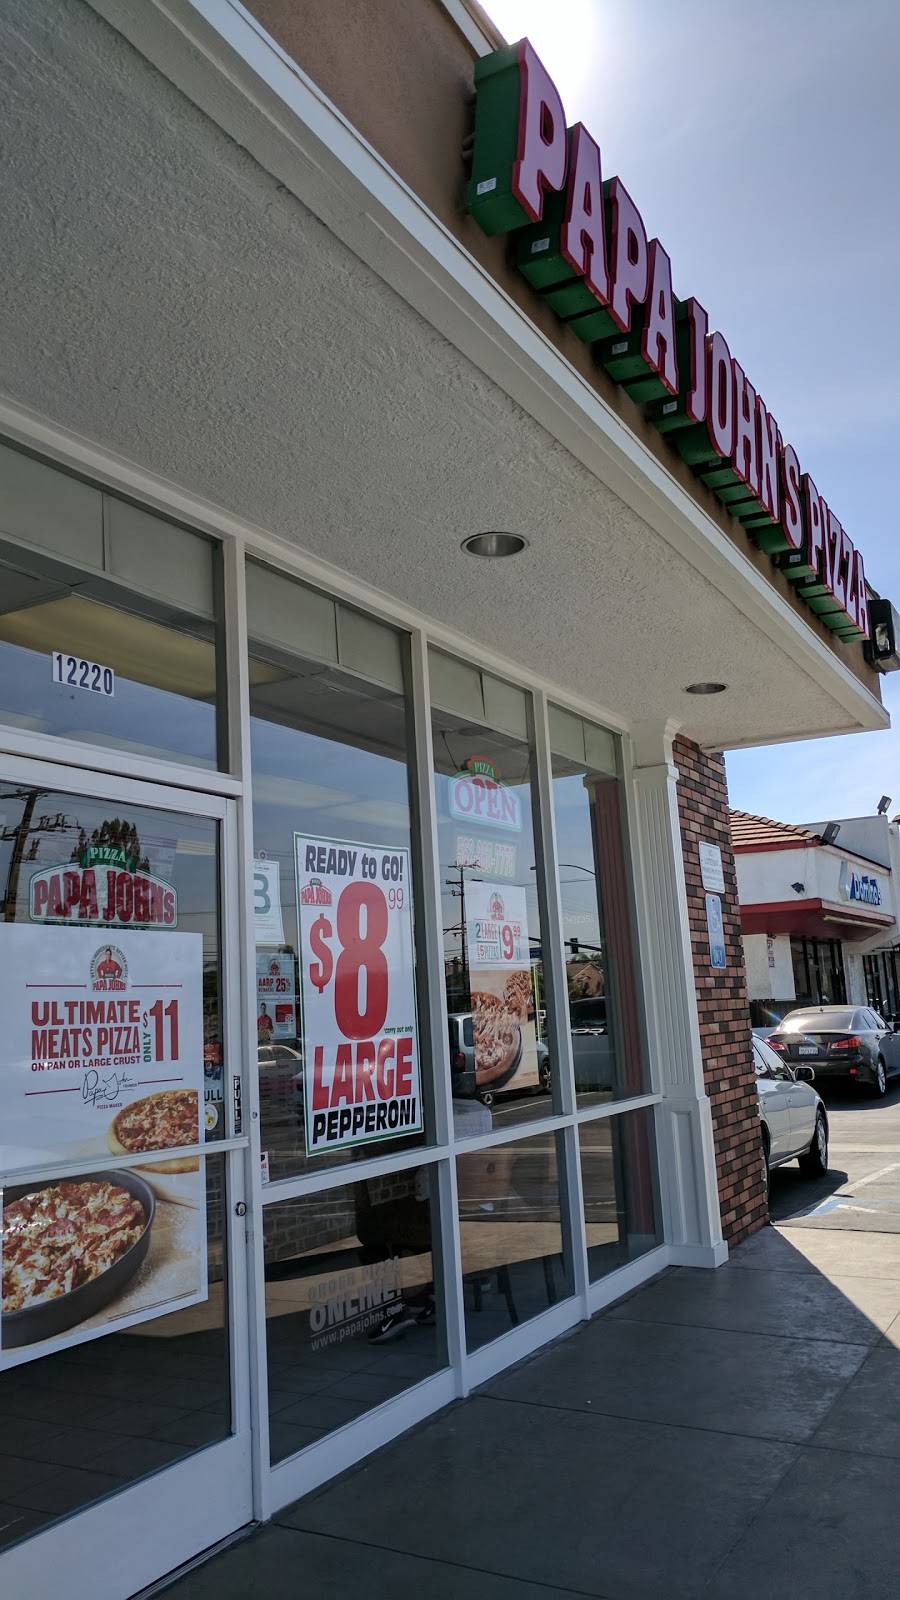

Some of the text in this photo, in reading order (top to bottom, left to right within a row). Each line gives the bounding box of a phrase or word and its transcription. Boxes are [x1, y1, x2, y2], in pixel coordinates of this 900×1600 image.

[512, 37, 870, 641] PAPA JOHN'S PIZZA
[56, 654, 113, 695] 12220
[474, 762, 495, 778] PIZZA
[454, 779, 518, 825] OPEN
[90, 847, 127, 863] PIZZA
[305, 845, 404, 882] READY to GO!
[34, 870, 175, 925] PAPA JOHN'S
[474, 922, 482, 939] 2
[31, 999, 141, 1027] ULTIMATE
[31, 1026, 140, 1061] MEATS PIZZA
[143, 1032, 152, 1063] ONLY
[31, 1055, 141, 1072] ON PAN OR LARGE CRUST
[312, 1038, 413, 1111] LARGE
[204, 1089, 222, 1102] ULL
[312, 1097, 417, 1145] PEPPERONI
[309, 1272, 404, 1332] ONLINE!
